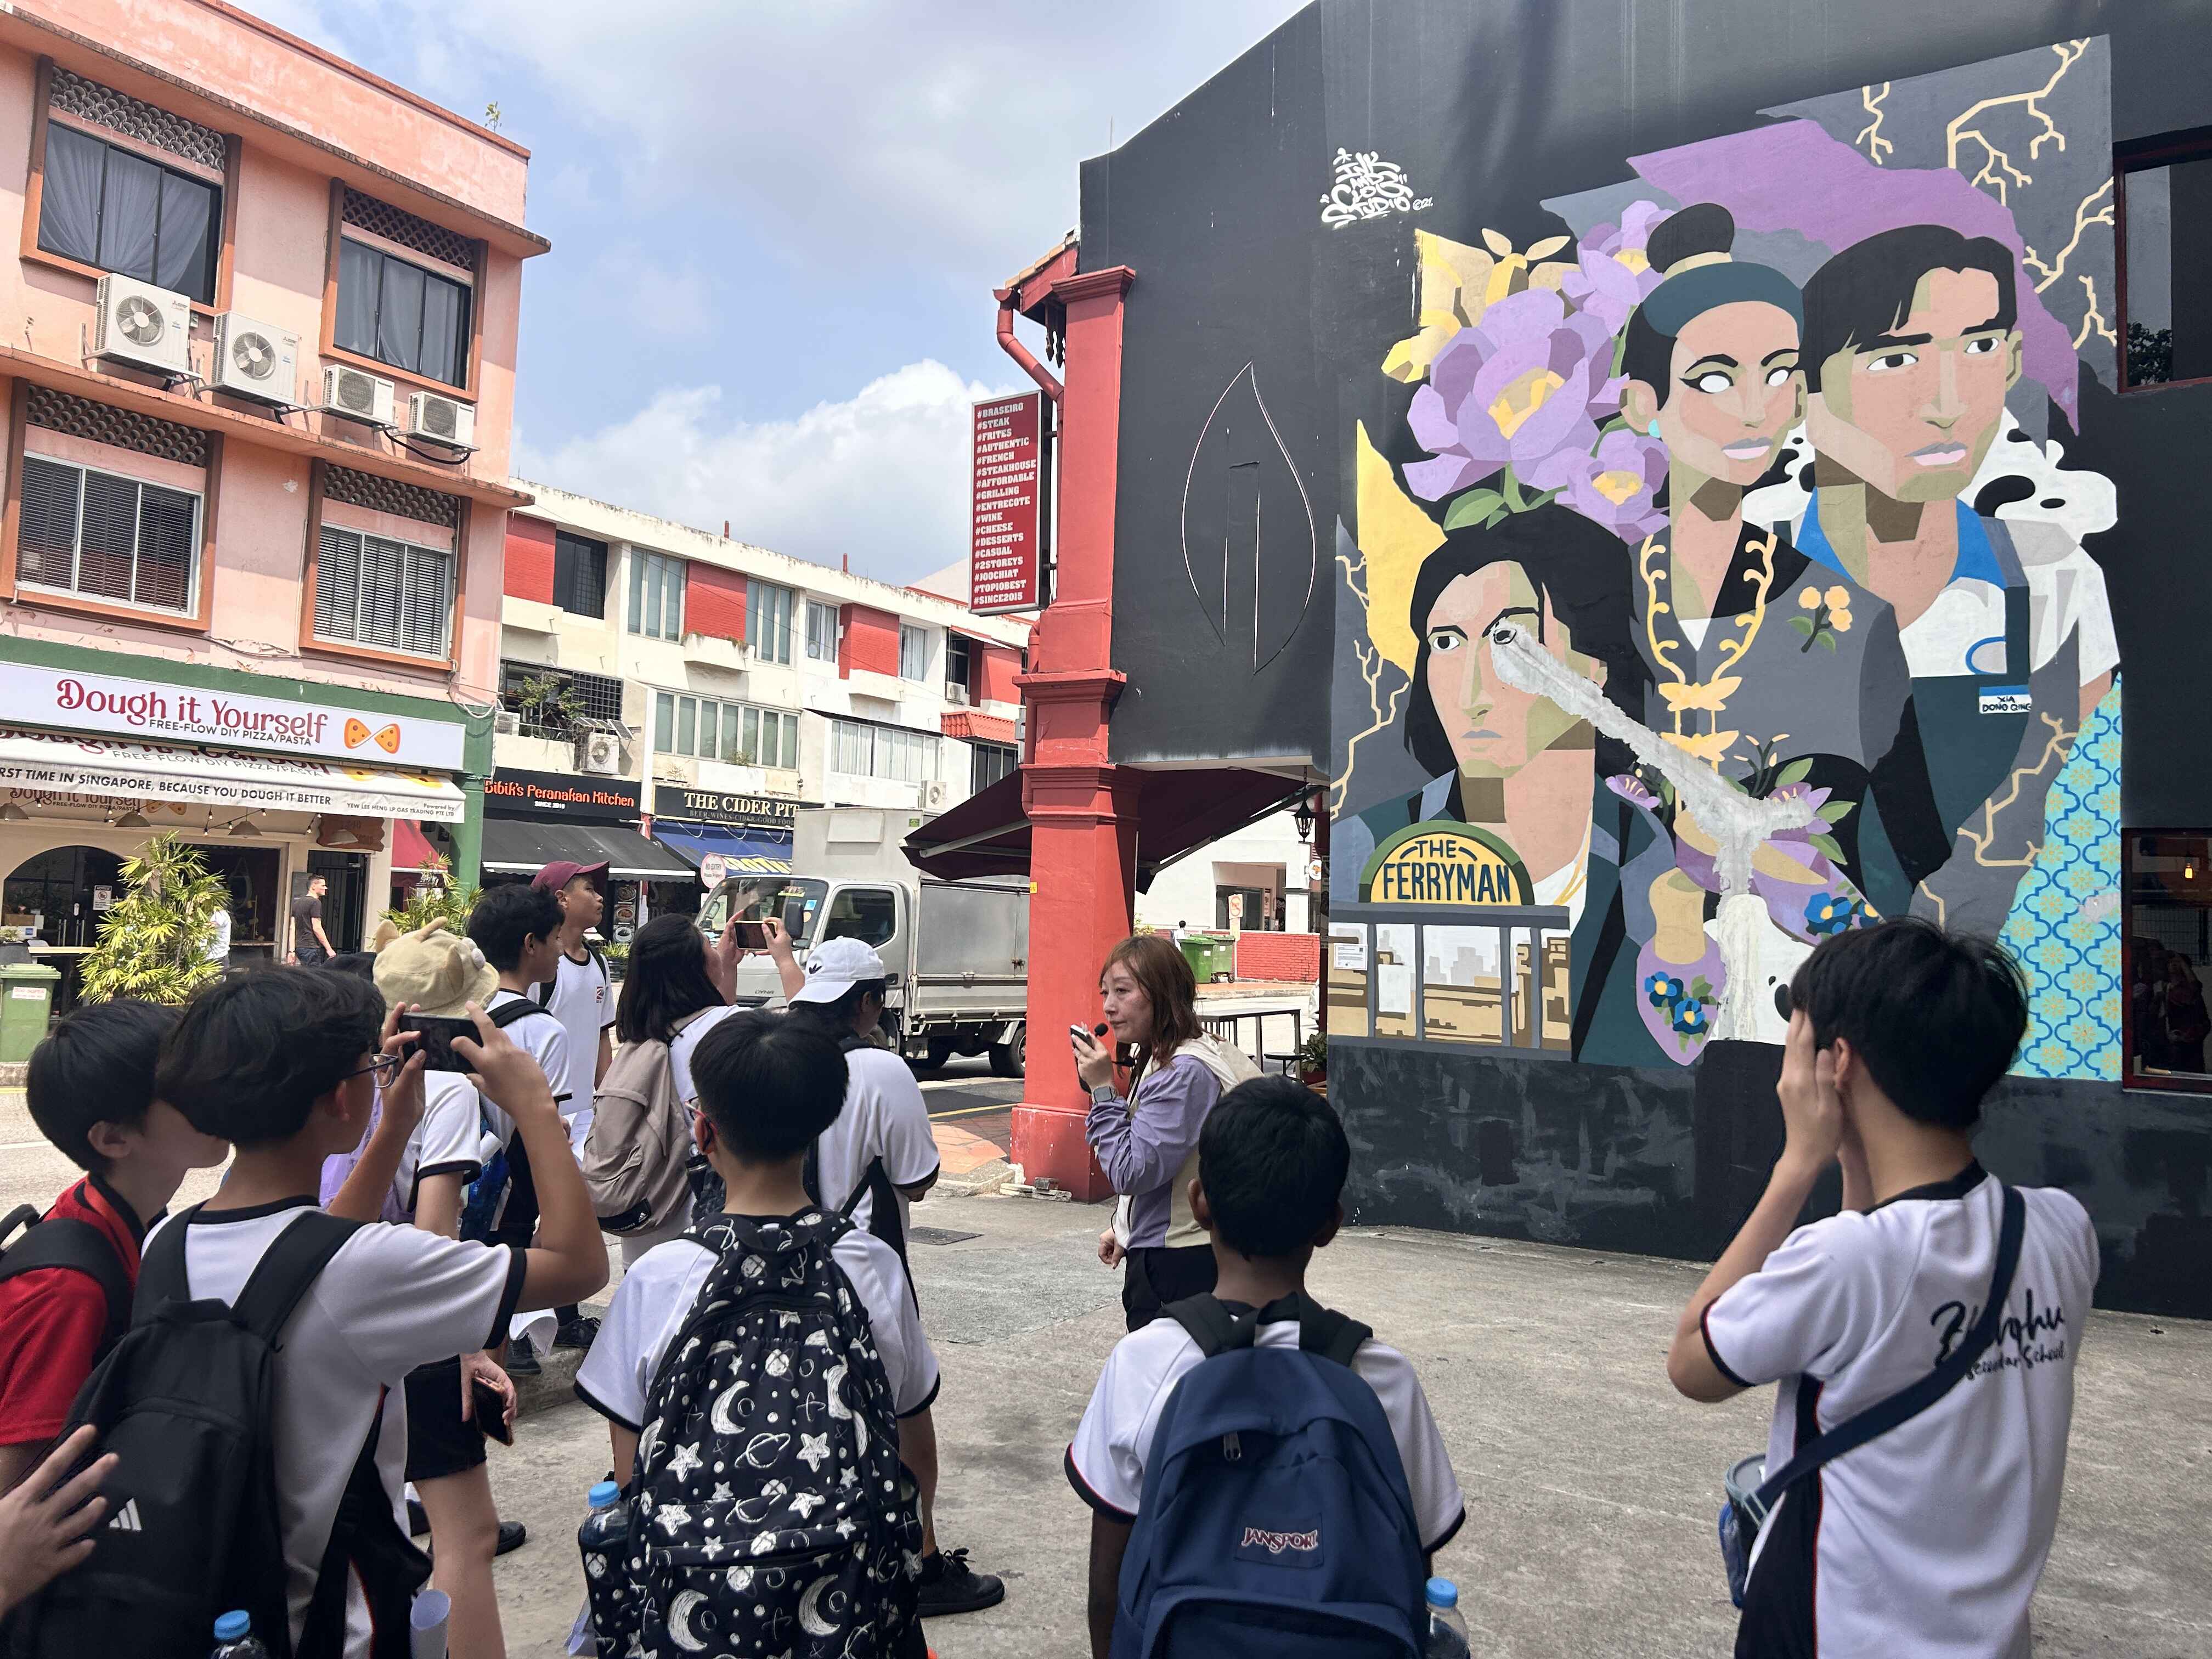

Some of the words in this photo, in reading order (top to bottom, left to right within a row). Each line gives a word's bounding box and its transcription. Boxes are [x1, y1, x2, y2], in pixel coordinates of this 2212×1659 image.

[977, 402, 1024, 419] #BRASEIRO
[977, 417, 1009, 430] #STEAK
[977, 428, 1012, 442] #FRITES
[977, 437, 1029, 453] #AUTHENTIC
[977, 451, 1014, 465] #FRENCH
[977, 459, 1036, 477] #STEAKHOUSE
[976, 471, 1035, 488] #AFFORDABLE
[976, 486, 1019, 500] #GRILLING
[975, 496, 1030, 512] #ENTRECOTE
[975, 512, 1003, 523] #WINE
[975, 522, 1013, 535] #CHEESE
[975, 532, 1024, 547] #DESSERTS
[975, 546, 1012, 558] #CASUAL
[974, 556, 1023, 570] #2STOREYS
[974, 569, 1019, 582] #JOOCHIAT
[974, 579, 1026, 594] #TOP10BEST
[974, 592, 1023, 605] #SINCE2015
[57, 679, 166, 726] Dough
[178, 696, 202, 724] it
[211, 699, 329, 743] Yourself
[149, 719, 217, 735] FREE-FLOW
[221, 727, 240, 738] DIY
[242, 730, 312, 746] PIZZA/PASTA
[112, 751, 201, 764] FREE-FLOW
[205, 758, 228, 766] DIY
[26, 769, 56, 782] TIME
[59, 772, 75, 783] IN
[78, 774, 155, 792] SINGAPORE,
[159, 781, 210, 795] BECAUSE
[213, 787, 238, 798] YOU
[241, 789, 283, 801] DOUGH
[286, 792, 295, 802] IT
[298, 793, 331, 805] BETTER
[527, 785, 590, 803] Peranakan
[592, 791, 635, 808] Kitchen
[684, 792, 719, 810] THE
[722, 797, 771, 816] CIDER
[775, 802, 800, 818] PIT
[1415, 839, 1457, 859] THE
[1383, 862, 1512, 903] FERRYMAN
[1241, 1527, 1318, 1554] JANSPORT
